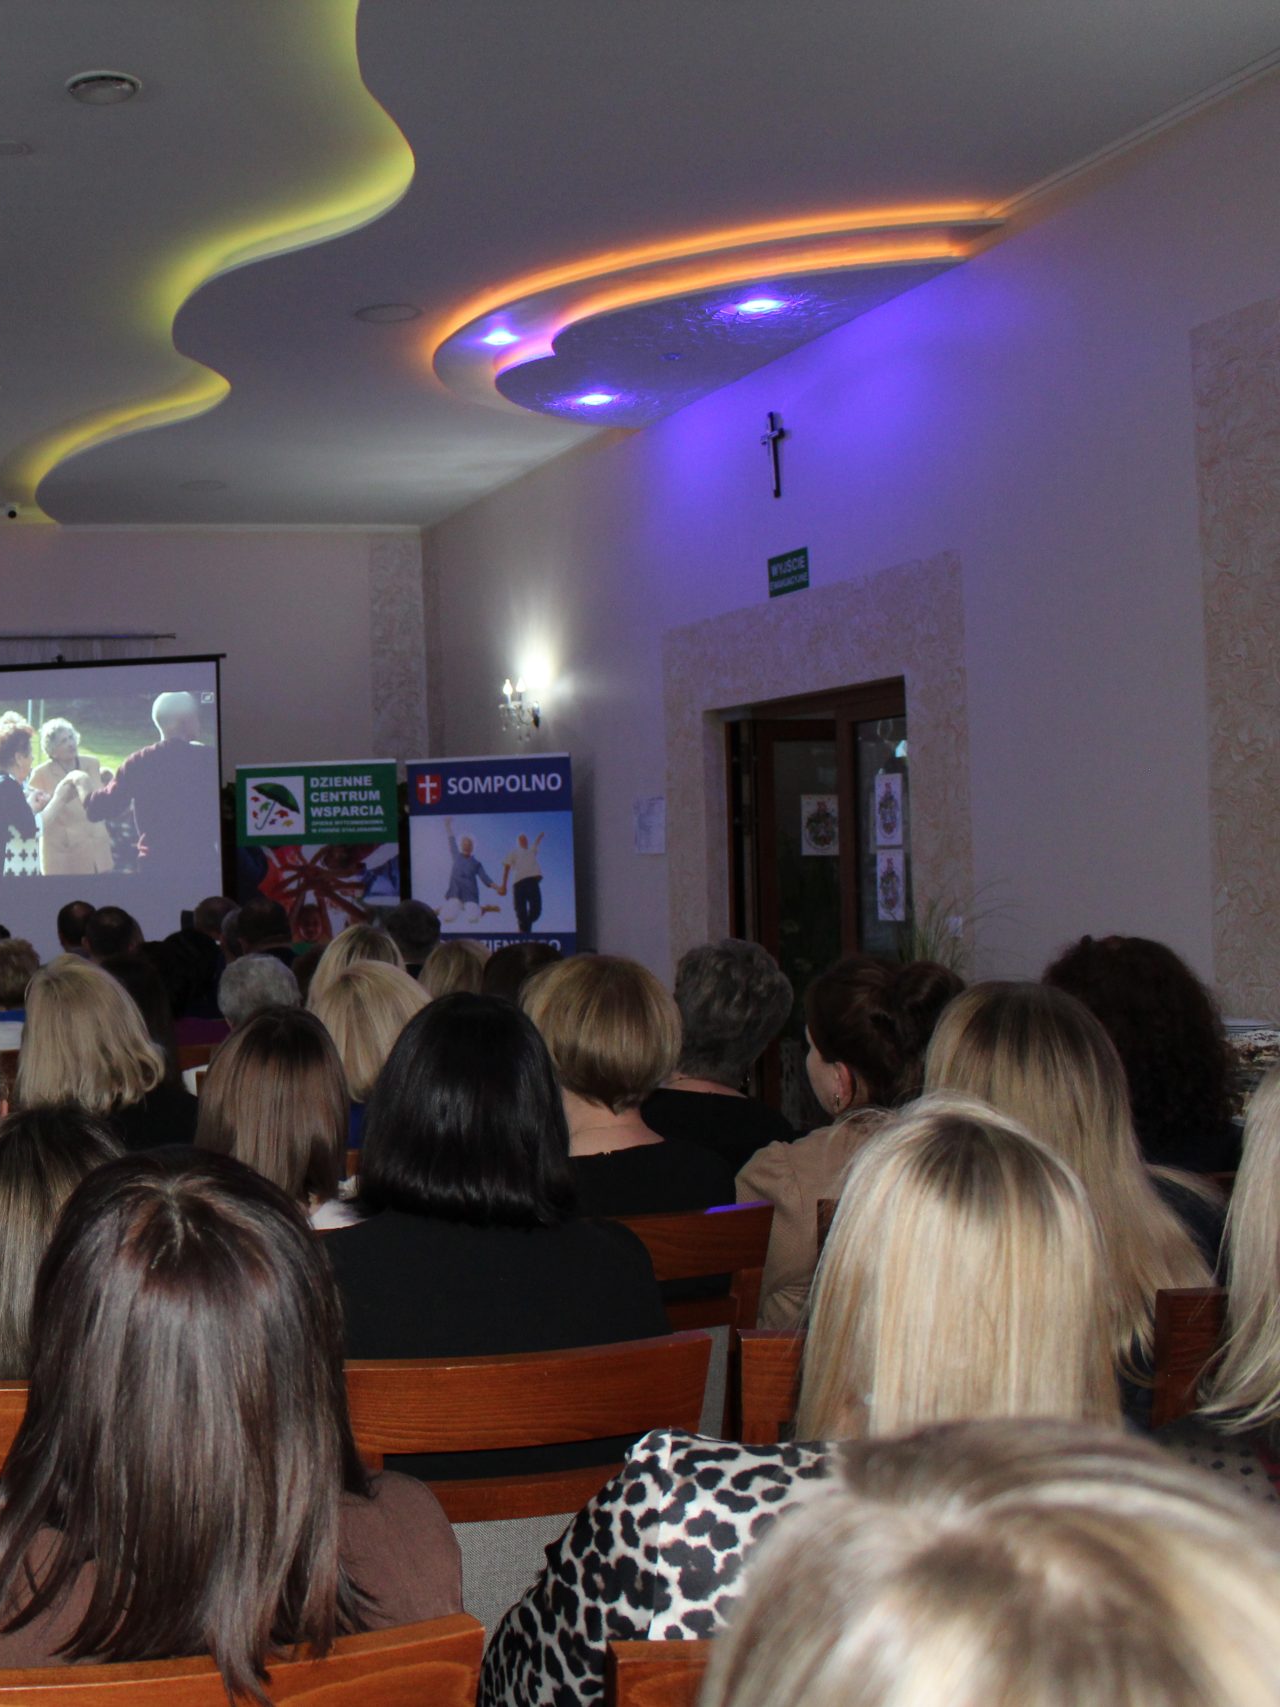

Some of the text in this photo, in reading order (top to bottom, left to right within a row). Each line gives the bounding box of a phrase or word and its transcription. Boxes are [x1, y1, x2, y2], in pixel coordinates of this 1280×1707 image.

[310, 775, 373, 788] DZIENNE
[447, 773, 563, 795] SOMPOLNO
[310, 790, 381, 803] CENTRUM
[311, 805, 384, 818] WSPARCIA
